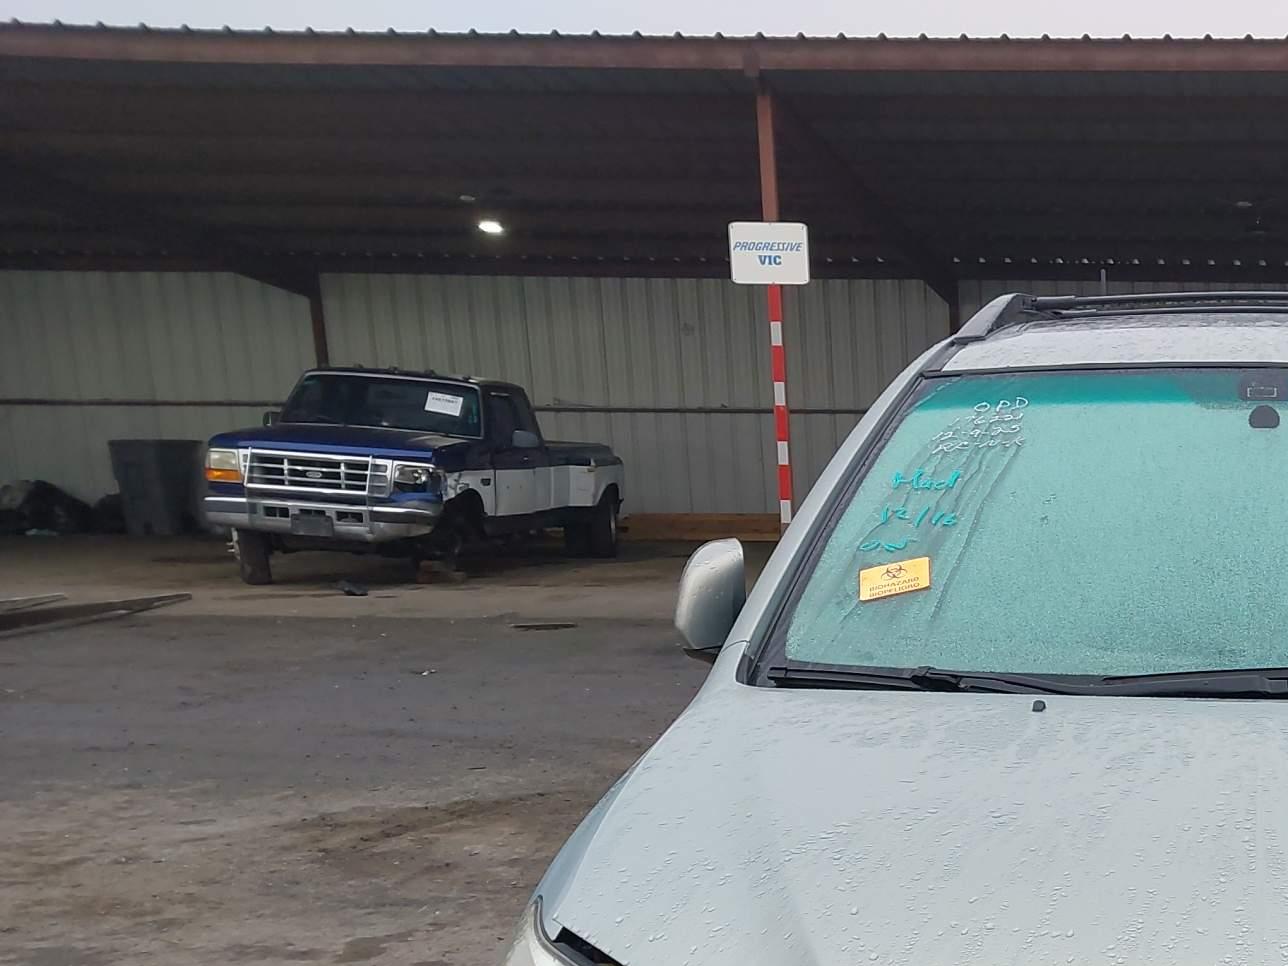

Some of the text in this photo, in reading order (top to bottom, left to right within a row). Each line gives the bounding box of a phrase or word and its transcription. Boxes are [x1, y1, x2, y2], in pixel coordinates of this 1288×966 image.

[733, 241, 803, 252] PROGRESSIVE
[758, 254, 782, 266] VIC
[869, 576, 920, 592] BIOHAZARD
